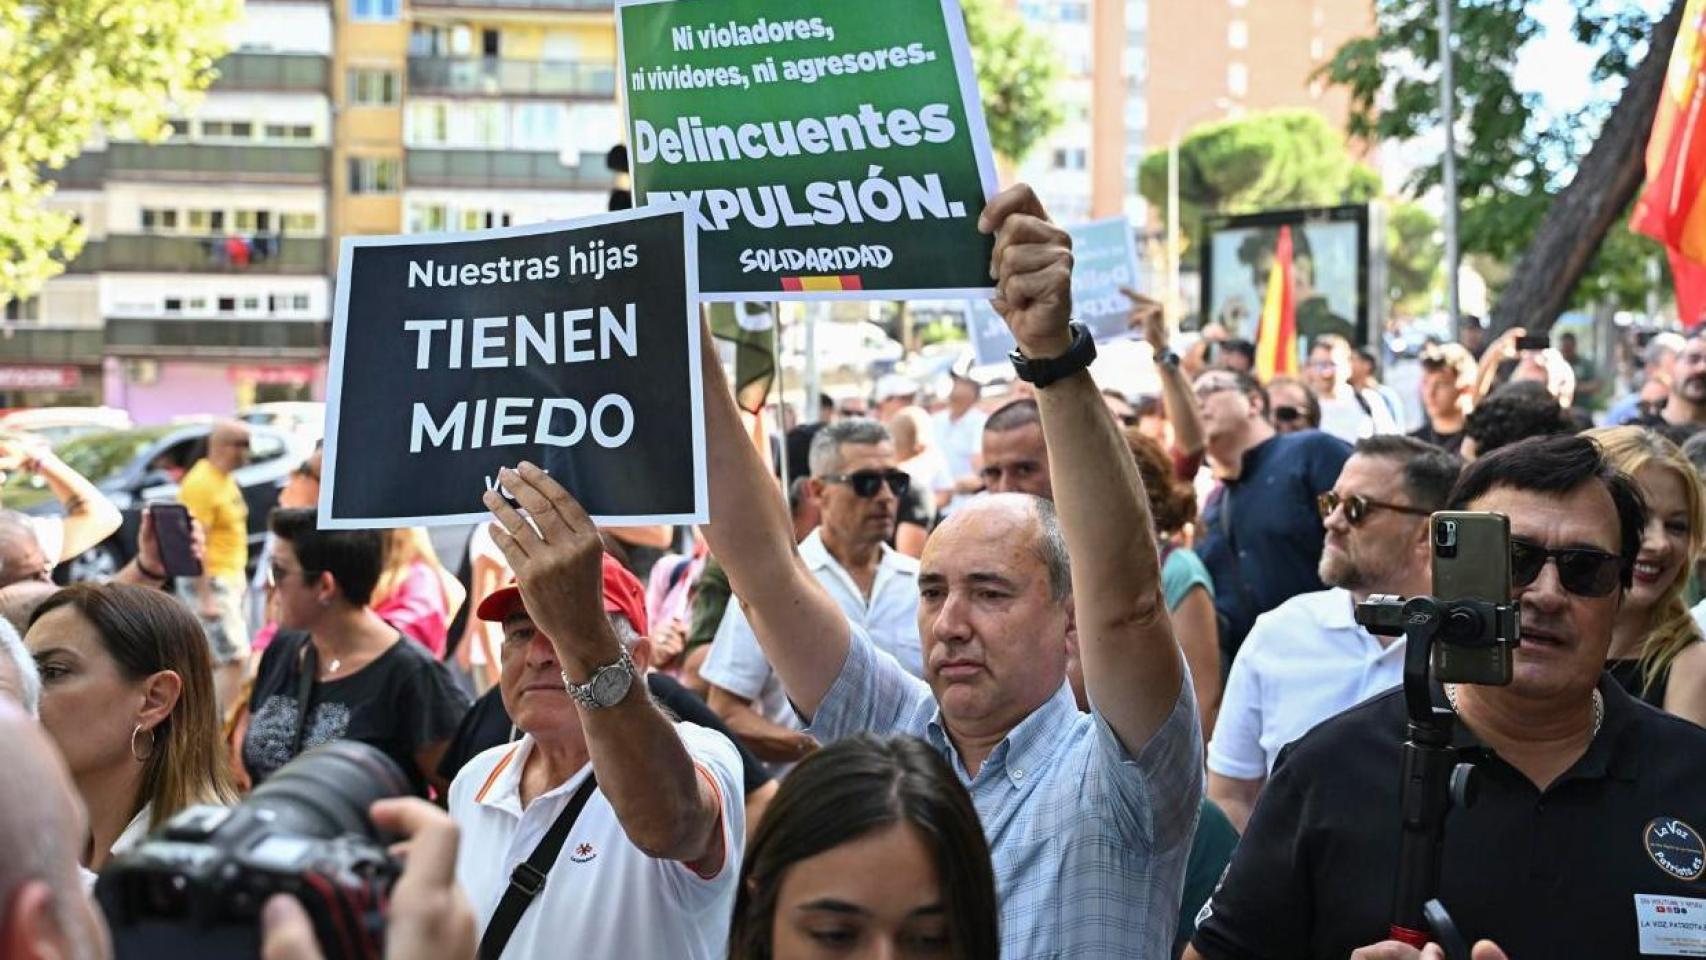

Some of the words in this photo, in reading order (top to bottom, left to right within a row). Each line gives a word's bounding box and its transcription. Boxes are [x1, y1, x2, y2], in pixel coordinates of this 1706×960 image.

[671, 25, 694, 51] Ni
[698, 16, 835, 50] violadores,
[632, 69, 646, 91] ni
[648, 65, 750, 91] vividores,
[753, 57, 778, 84] ni
[782, 42, 937, 84] agresores.
[635, 103, 956, 164] Delincuentes
[407, 252, 561, 289] Nuestras
[569, 240, 639, 281] hijas
[739, 244, 894, 273] SOLIDARIDAD
[404, 303, 638, 370] TIENEN
[409, 392, 635, 454] MIEDO
